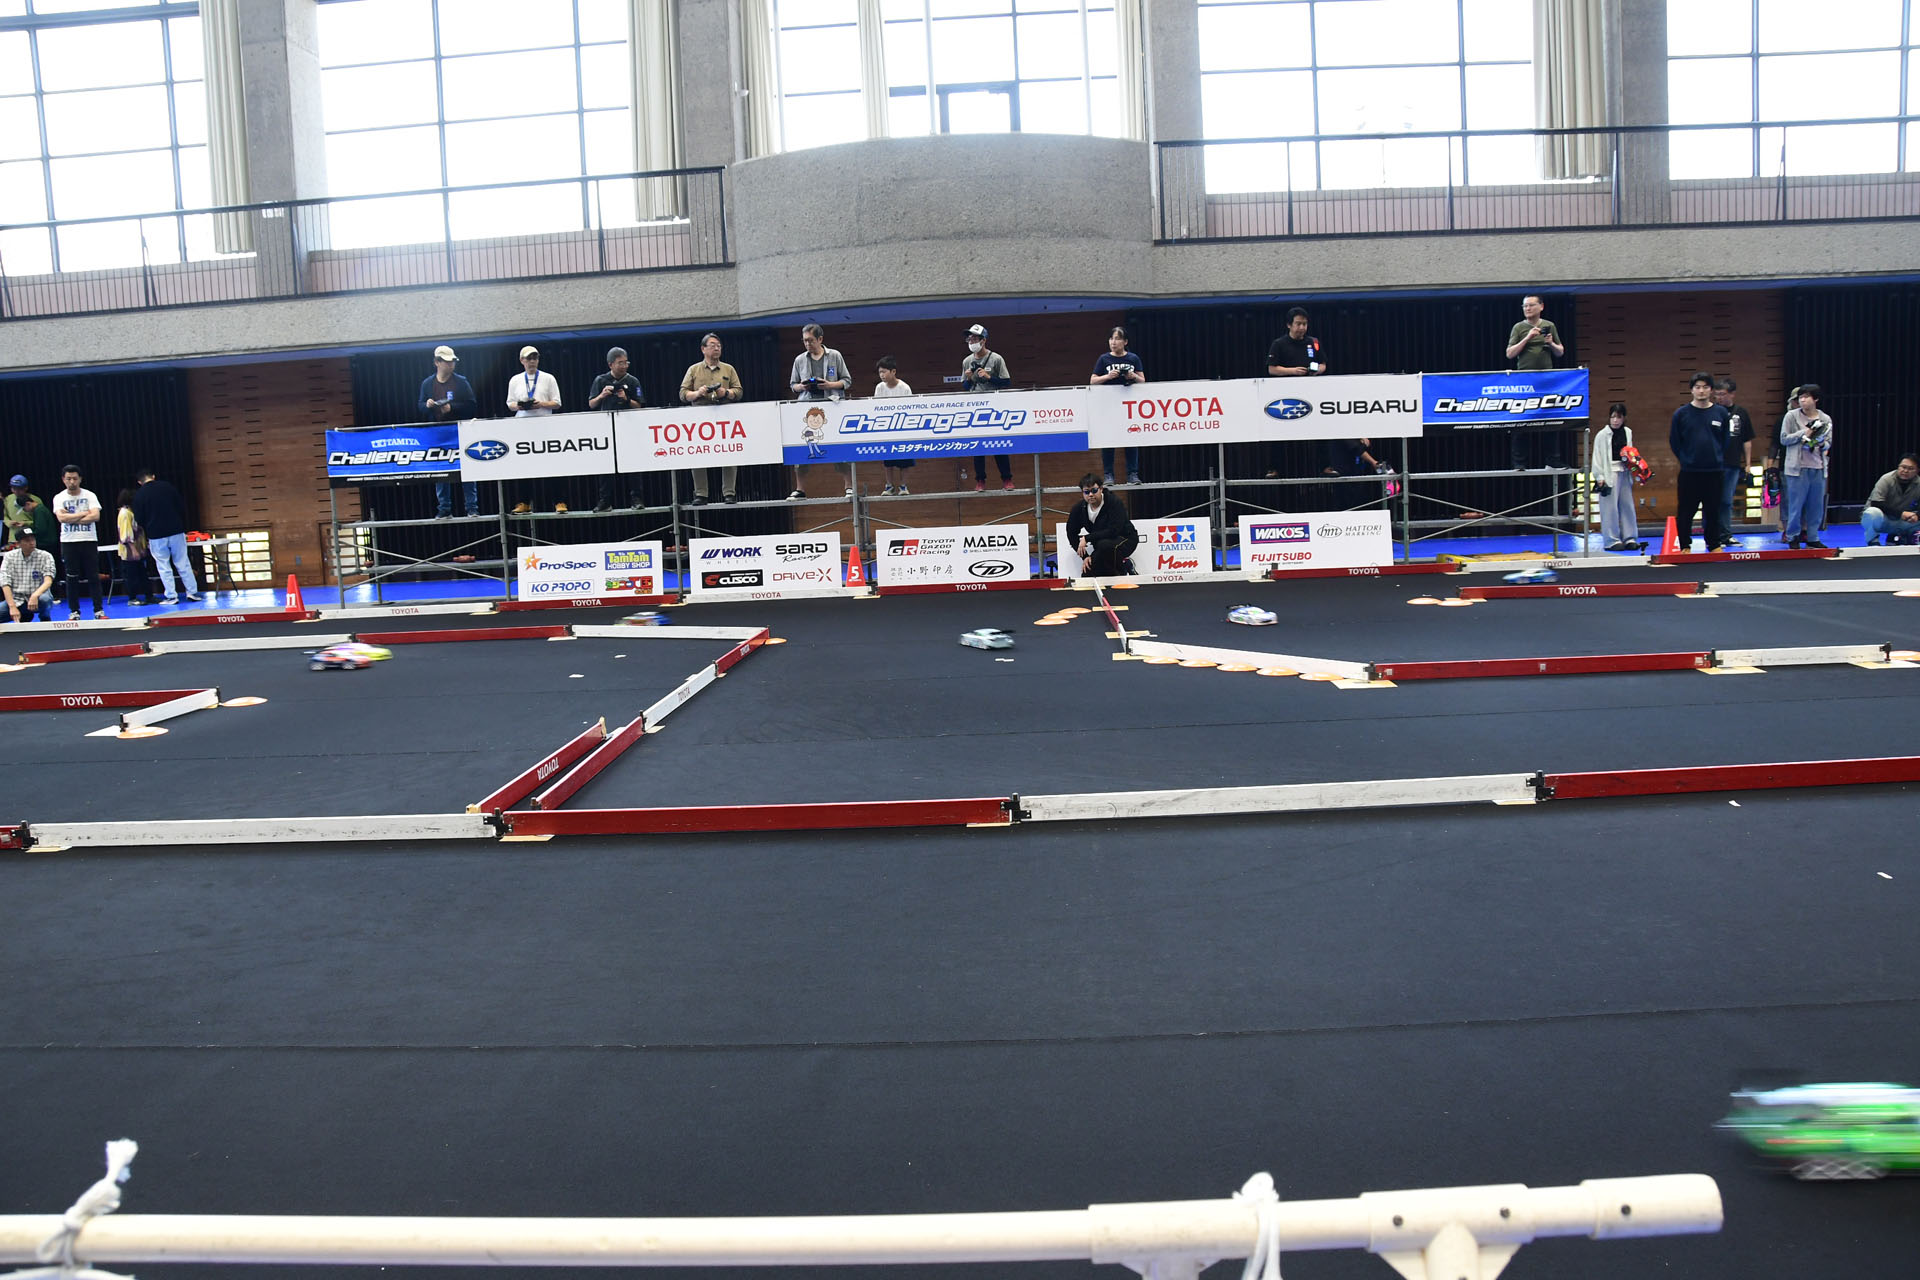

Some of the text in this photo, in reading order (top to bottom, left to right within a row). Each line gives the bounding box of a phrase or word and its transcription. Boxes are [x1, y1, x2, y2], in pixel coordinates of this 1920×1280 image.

[1499, 385, 1535, 393] TAMIYA
[1122, 396, 1224, 419] TOYOTA
[1319, 399, 1418, 415] SUBARU
[1434, 394, 1583, 413] Challenge Cup
[1033, 408, 1074, 418] TOYOTA
[838, 408, 1027, 434] Challenge Cup
[1143, 420, 1220, 432] RC CAR CLUB
[648, 420, 747, 444] TOYOTA
[387, 438, 421, 446] TAMIYA
[515, 437, 609, 455] SUBARU
[890, 440, 979, 453] トヨタチャレンジカップ
[669, 443, 744, 456] RC CAR CLUB
[328, 447, 461, 465] Challenge Cup
[64, 523, 91, 533] STAGE
[963, 535, 1018, 548] MAEDA
[1158, 543, 1196, 551] TAMIYA
[722, 546, 762, 558] WORK
[888, 545, 918, 556] GR
[1730, 552, 1761, 560] TOYOTA
[607, 551, 649, 563] TamTam
[782, 554, 823, 563] Racing
[1158, 554, 1199, 570] Mom
[1251, 552, 1312, 562] FUJITSUBO
[1543, 560, 1573, 568] TOYOTA
[851, 565, 860, 579] 5
[1152, 574, 1184, 582] TOYOTA
[531, 581, 591, 592] KO PROPO
[955, 583, 987, 591] TOYOTA
[1558, 586, 1597, 595] TOYOTA
[571, 599, 602, 607] TOYOTA
[217, 615, 246, 623] TOYOTA
[60, 695, 104, 706] TOYOTA
[537, 757, 560, 781] TOYOTA
